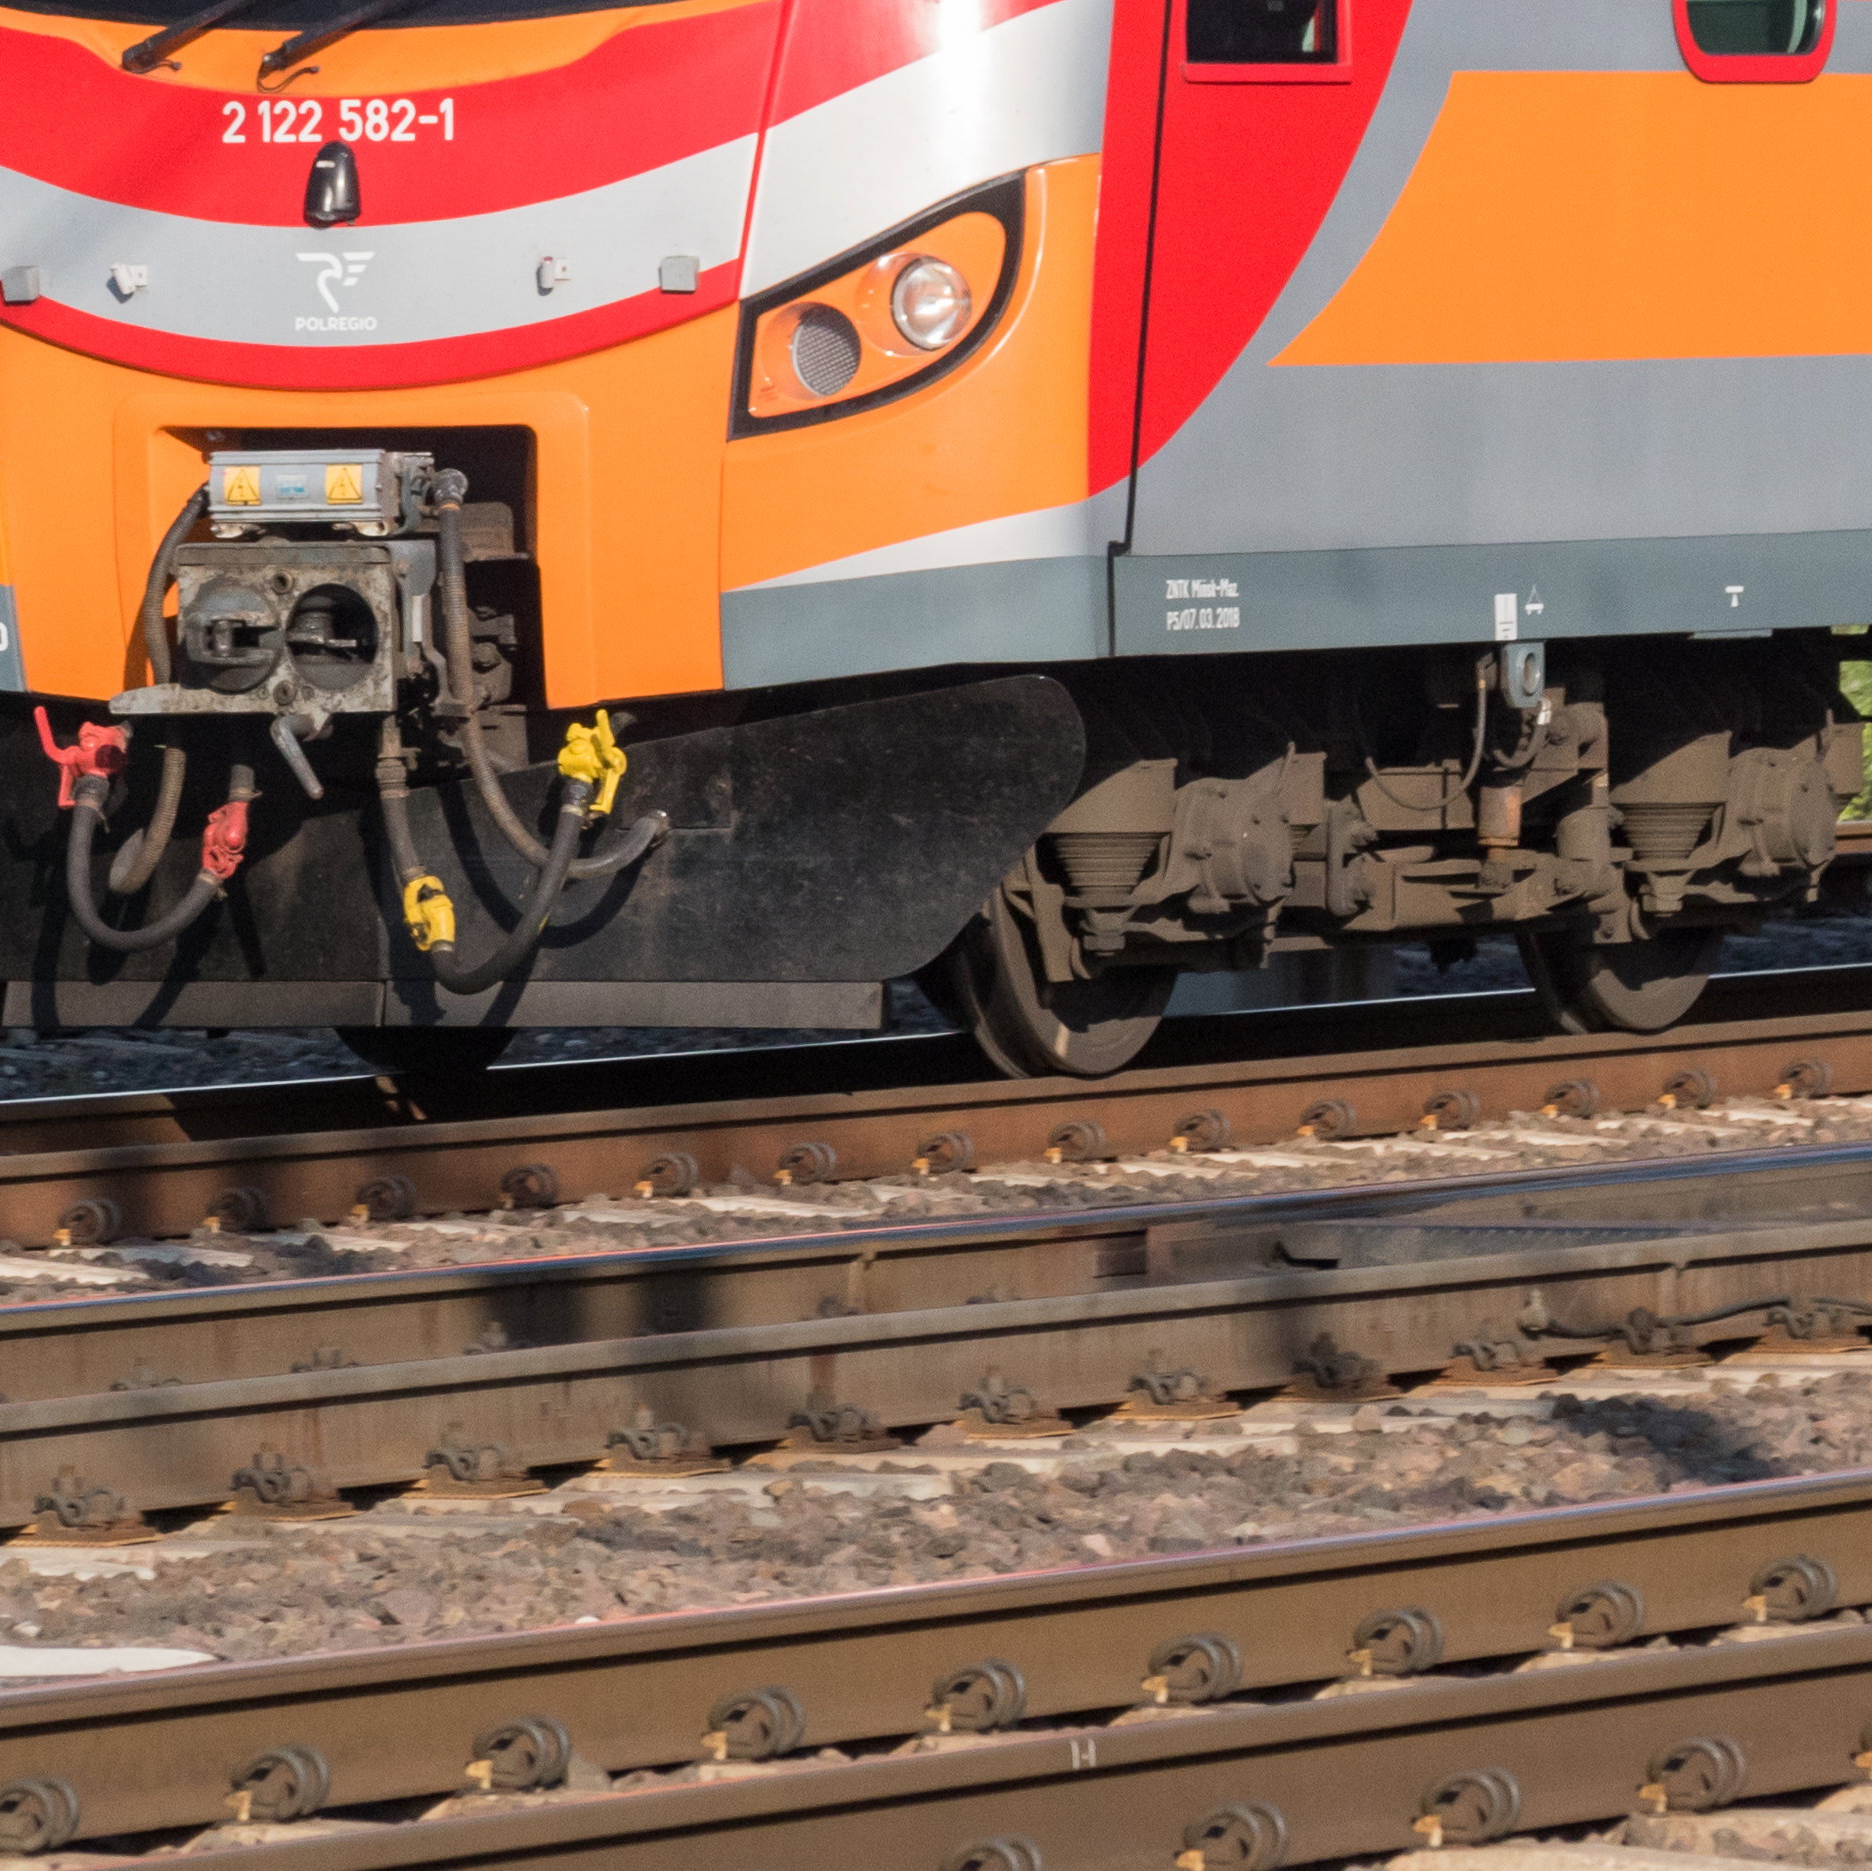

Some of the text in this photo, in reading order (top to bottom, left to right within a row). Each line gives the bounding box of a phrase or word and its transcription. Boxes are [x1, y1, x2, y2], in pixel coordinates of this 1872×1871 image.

[222, 98, 454, 143] 2 122 582-1
[295, 316, 377, 332] POLREGIO
